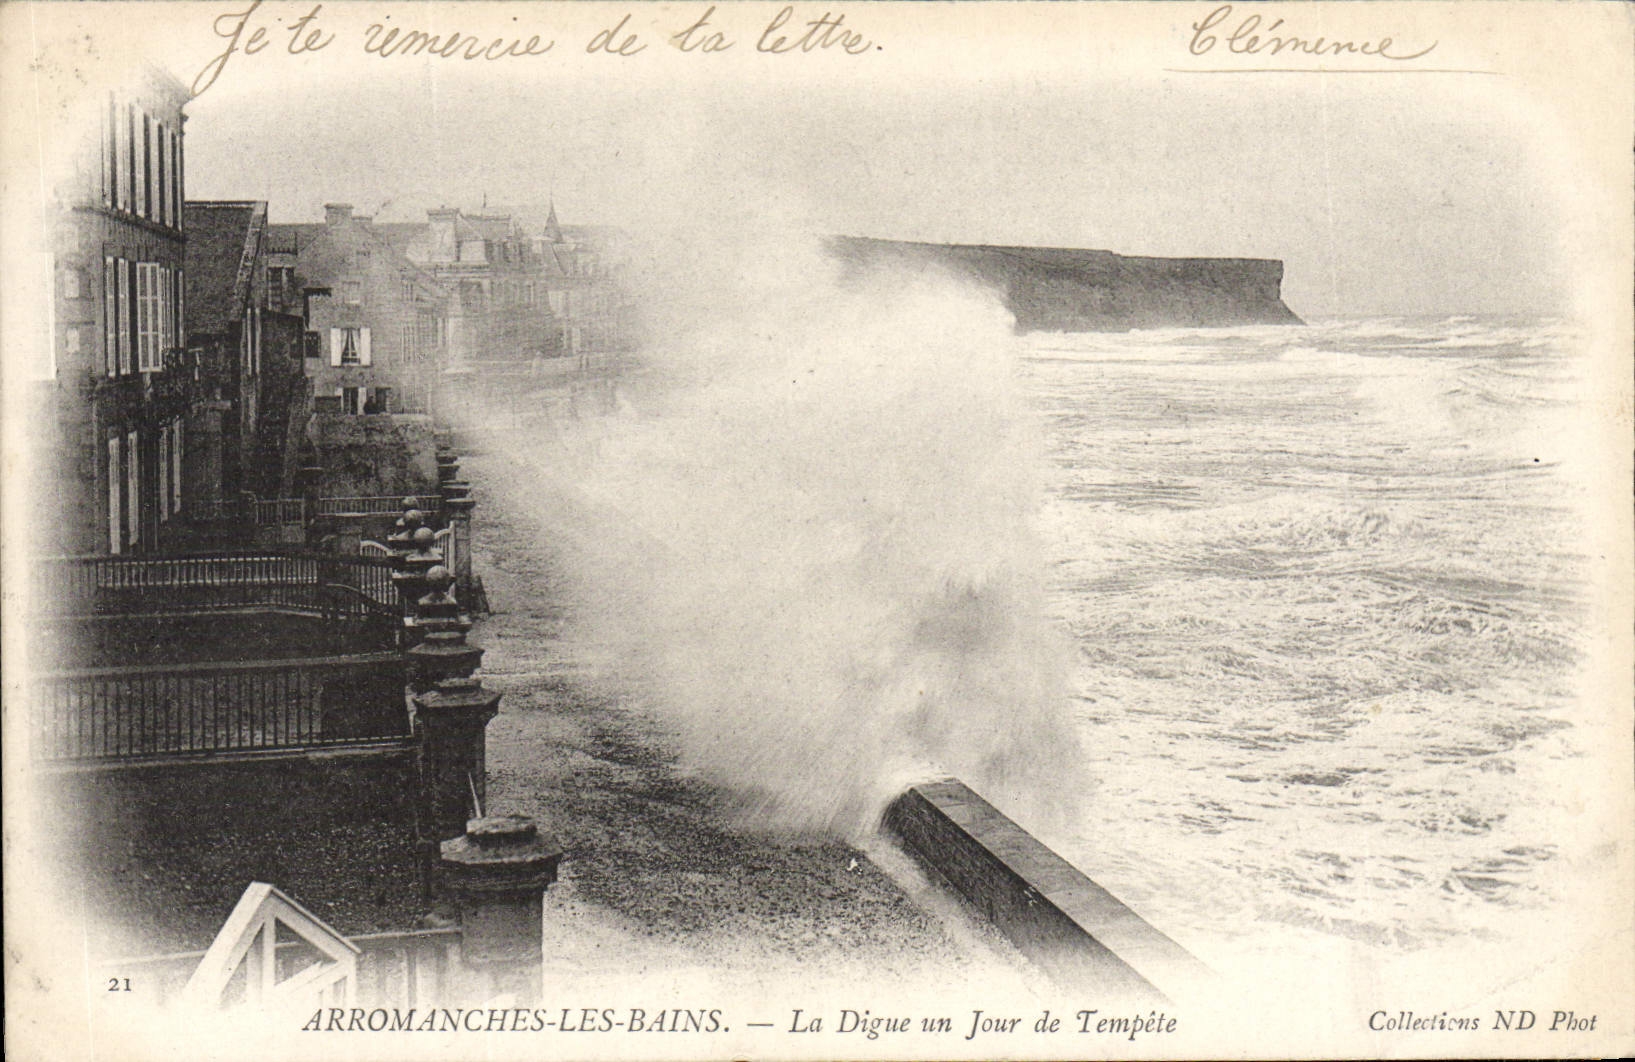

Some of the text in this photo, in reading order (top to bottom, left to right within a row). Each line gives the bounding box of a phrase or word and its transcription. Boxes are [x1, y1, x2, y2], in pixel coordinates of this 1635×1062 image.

[191, 0, 270, 97] Je
[287, 4, 335, 55] te
[364, 17, 555, 61] remercie
[586, 13, 648, 56] de
[756, 5, 883, 55] lettre.
[1189, 4, 1439, 61] Clémence
